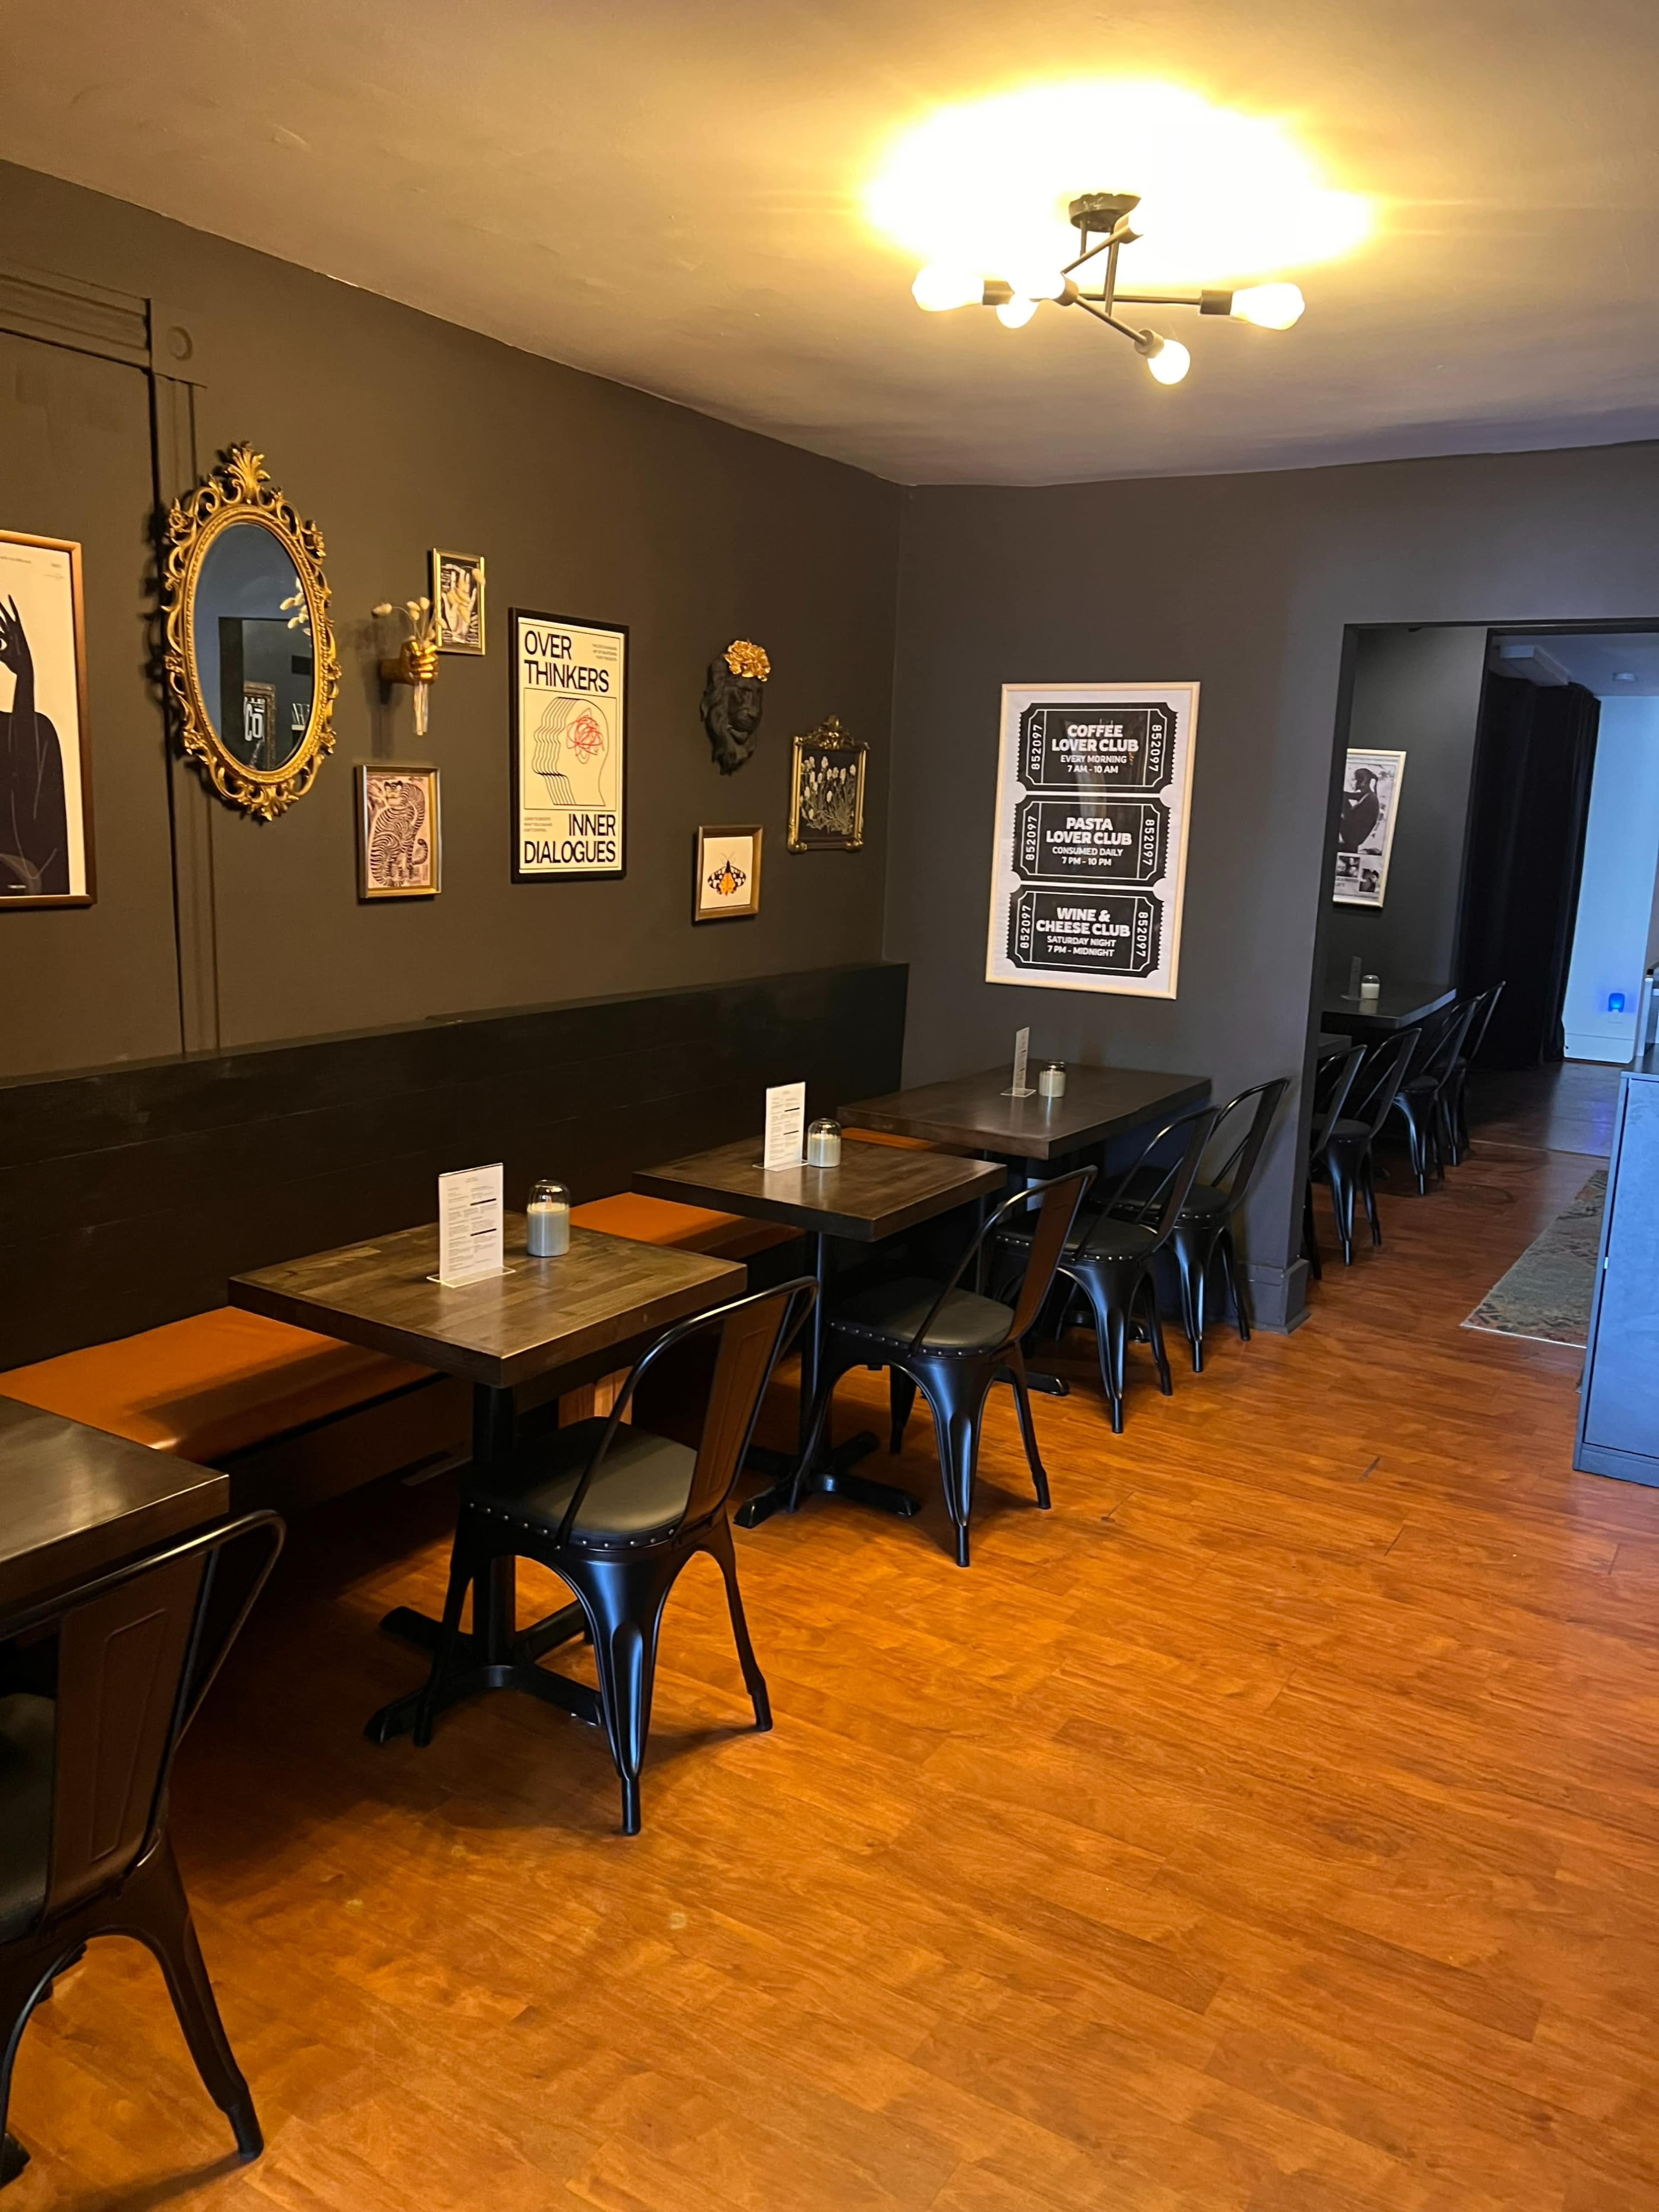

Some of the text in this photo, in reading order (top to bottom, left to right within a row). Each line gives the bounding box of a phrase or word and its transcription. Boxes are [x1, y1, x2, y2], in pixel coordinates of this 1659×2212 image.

[524, 630, 572, 660] OVER
[524, 659, 609, 693] THINKERS
[1068, 725, 1123, 737] COFFEE
[1031, 725, 1042, 770] 852097
[1052, 739, 1139, 752] LOVER CLUB
[1148, 725, 1162, 772] 852097
[1087, 755, 1127, 763] MORNING
[569, 814, 616, 836] INNER
[1066, 817, 1113, 831] PASTA
[1025, 816, 1037, 861] 852097
[1046, 830, 1132, 845] LOVER CLUB
[1142, 819, 1155, 865] 852097
[524, 841, 616, 864] DIALOGUES
[1052, 846, 1098, 855] CONSUMED
[1057, 907, 1110, 922] WINE &
[1020, 905, 1031, 948] 852097
[1036, 920, 1131, 937] CHEESE CLUB
[1136, 912, 1148, 957] 852097
[1047, 935, 1117, 947] SATURDAY NIGHT
[1073, 947, 1115, 957] MIDNIGHT
